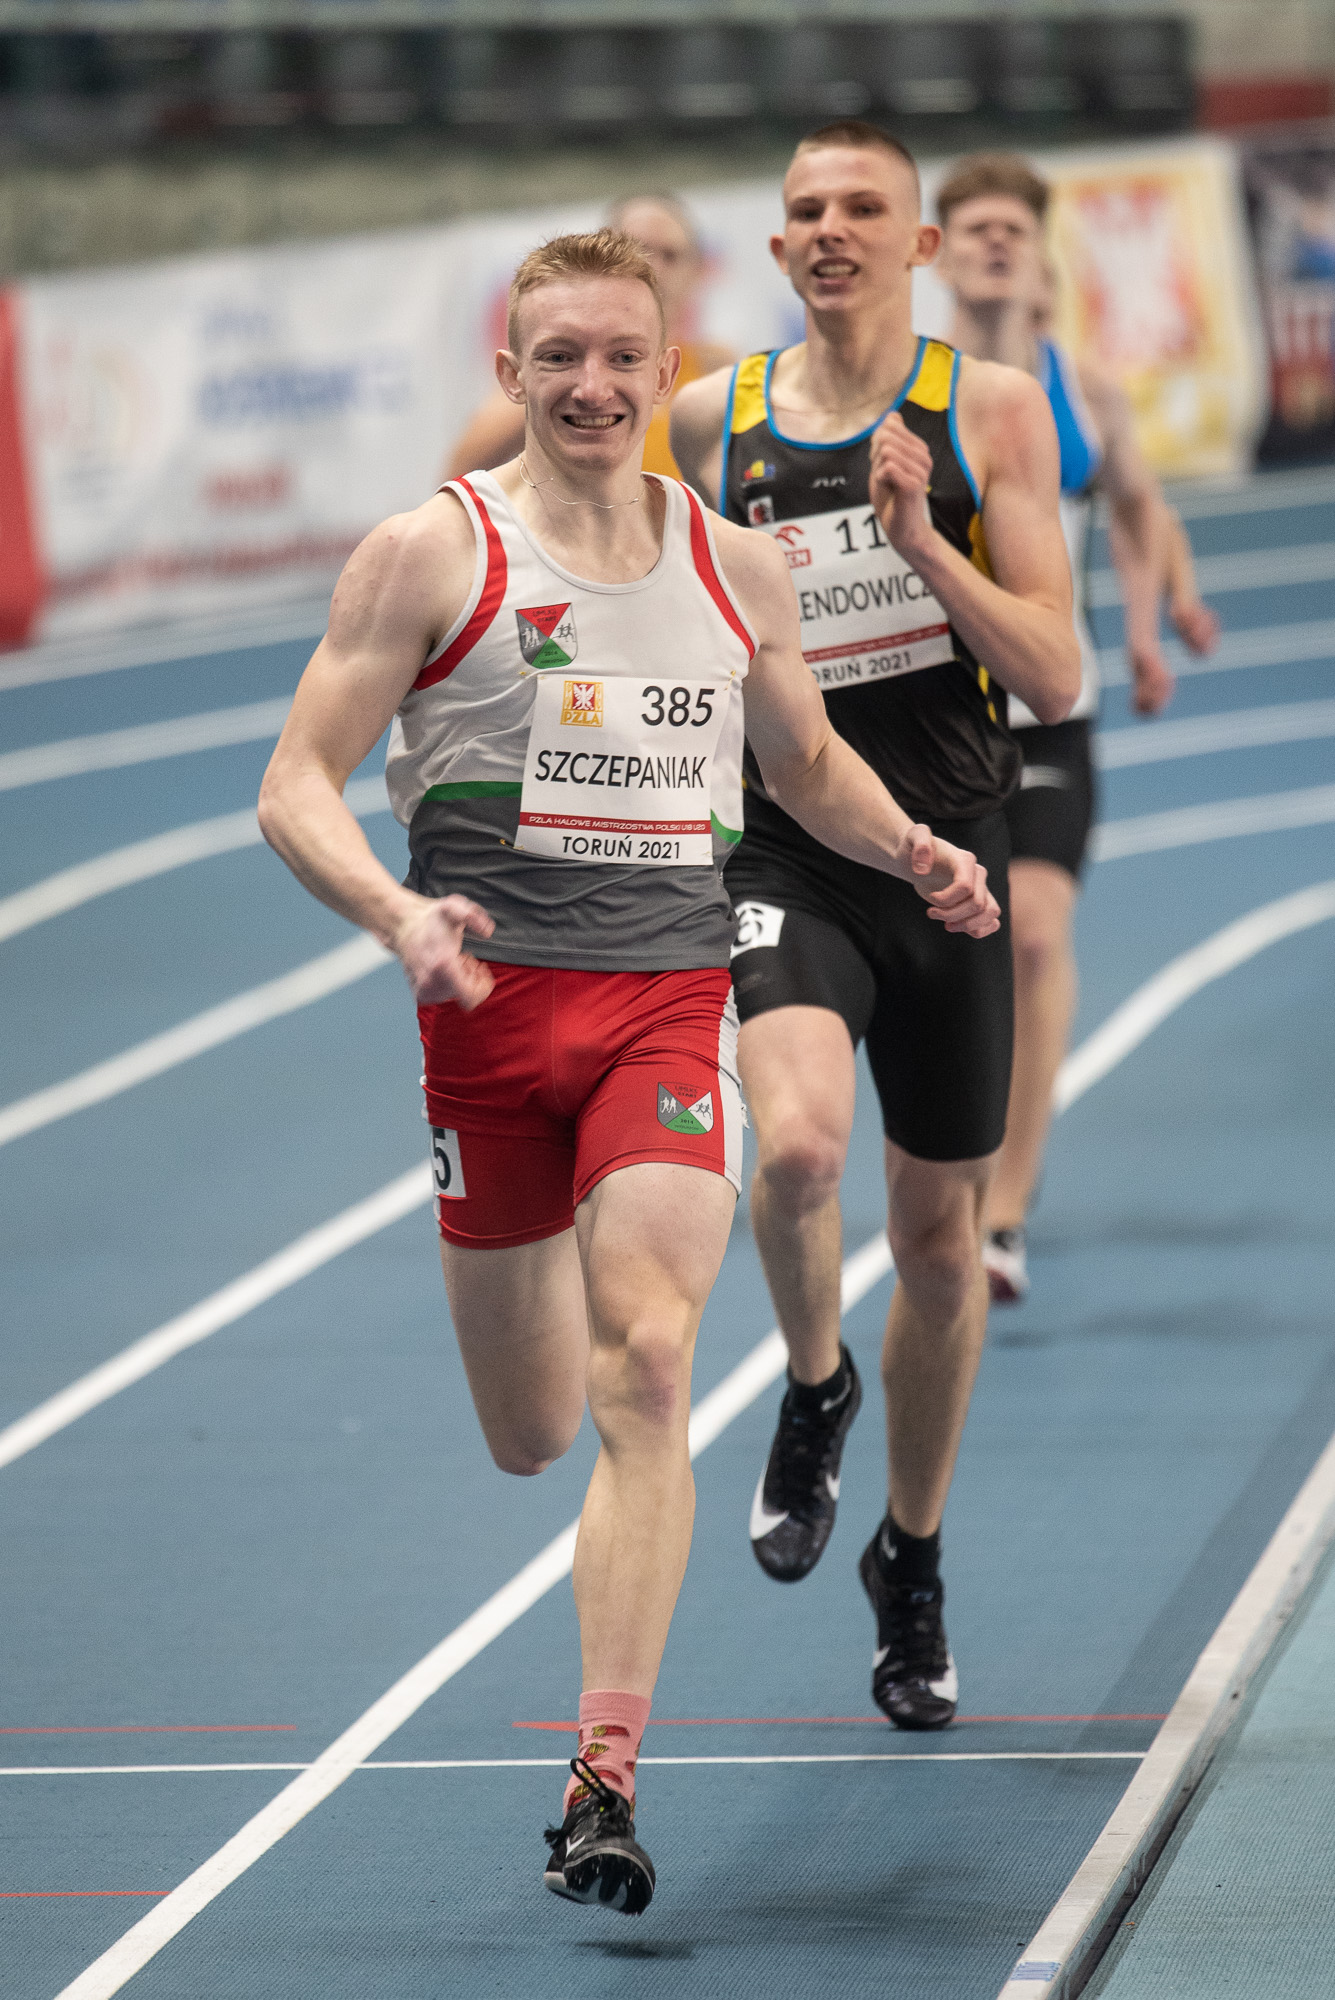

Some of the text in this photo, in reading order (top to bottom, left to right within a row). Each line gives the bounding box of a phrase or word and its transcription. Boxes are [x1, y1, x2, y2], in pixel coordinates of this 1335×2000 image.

[800, 571, 932, 621] ENDOWIC
[868, 651, 911, 676] 2021
[563, 711, 601, 725] PZLA
[641, 685, 715, 727] 385
[535, 750, 707, 789] SZCZEPANIAK
[529, 816, 706, 831] PZLA HALOWE MISTRZOSTWA POLSKI U18 U20
[562, 834, 680, 859] TORUŃ 2021
[432, 1126, 452, 1190] 5
